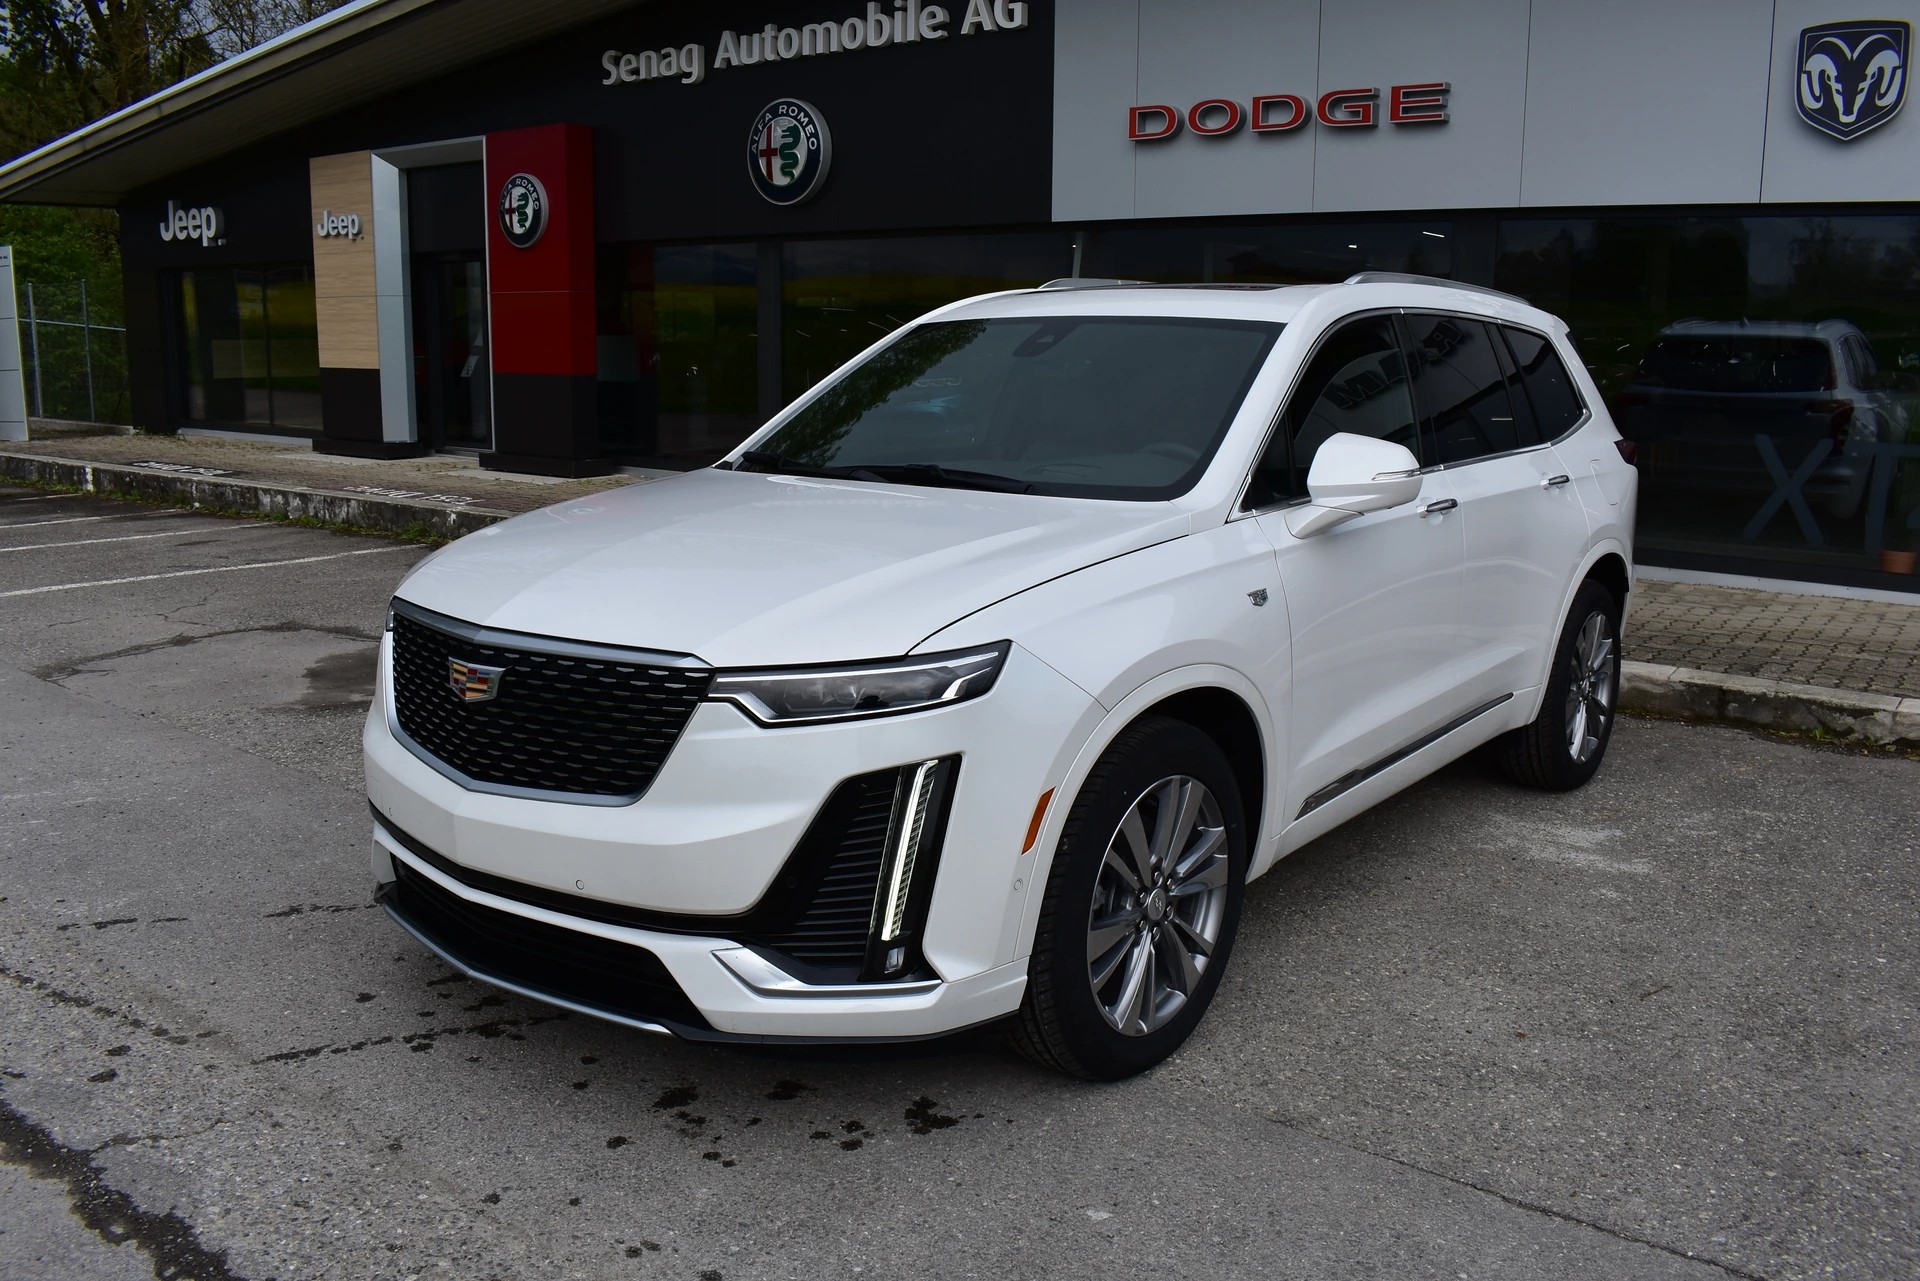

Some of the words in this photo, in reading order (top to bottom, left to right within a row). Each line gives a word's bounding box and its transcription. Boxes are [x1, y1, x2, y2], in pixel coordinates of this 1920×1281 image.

[602, 43, 704, 86] Senag
[713, 0, 950, 69] Automobile
[960, 0, 1029, 35] AG
[751, 112, 773, 154] ALFA
[778, 104, 818, 150] ROMEO
[1128, 81, 1451, 141] DODGE
[515, 178, 540, 210] ROMEO
[159, 199, 222, 247] Jeep
[317, 210, 363, 240] Jeep
[1743, 434, 1920, 553] XT
